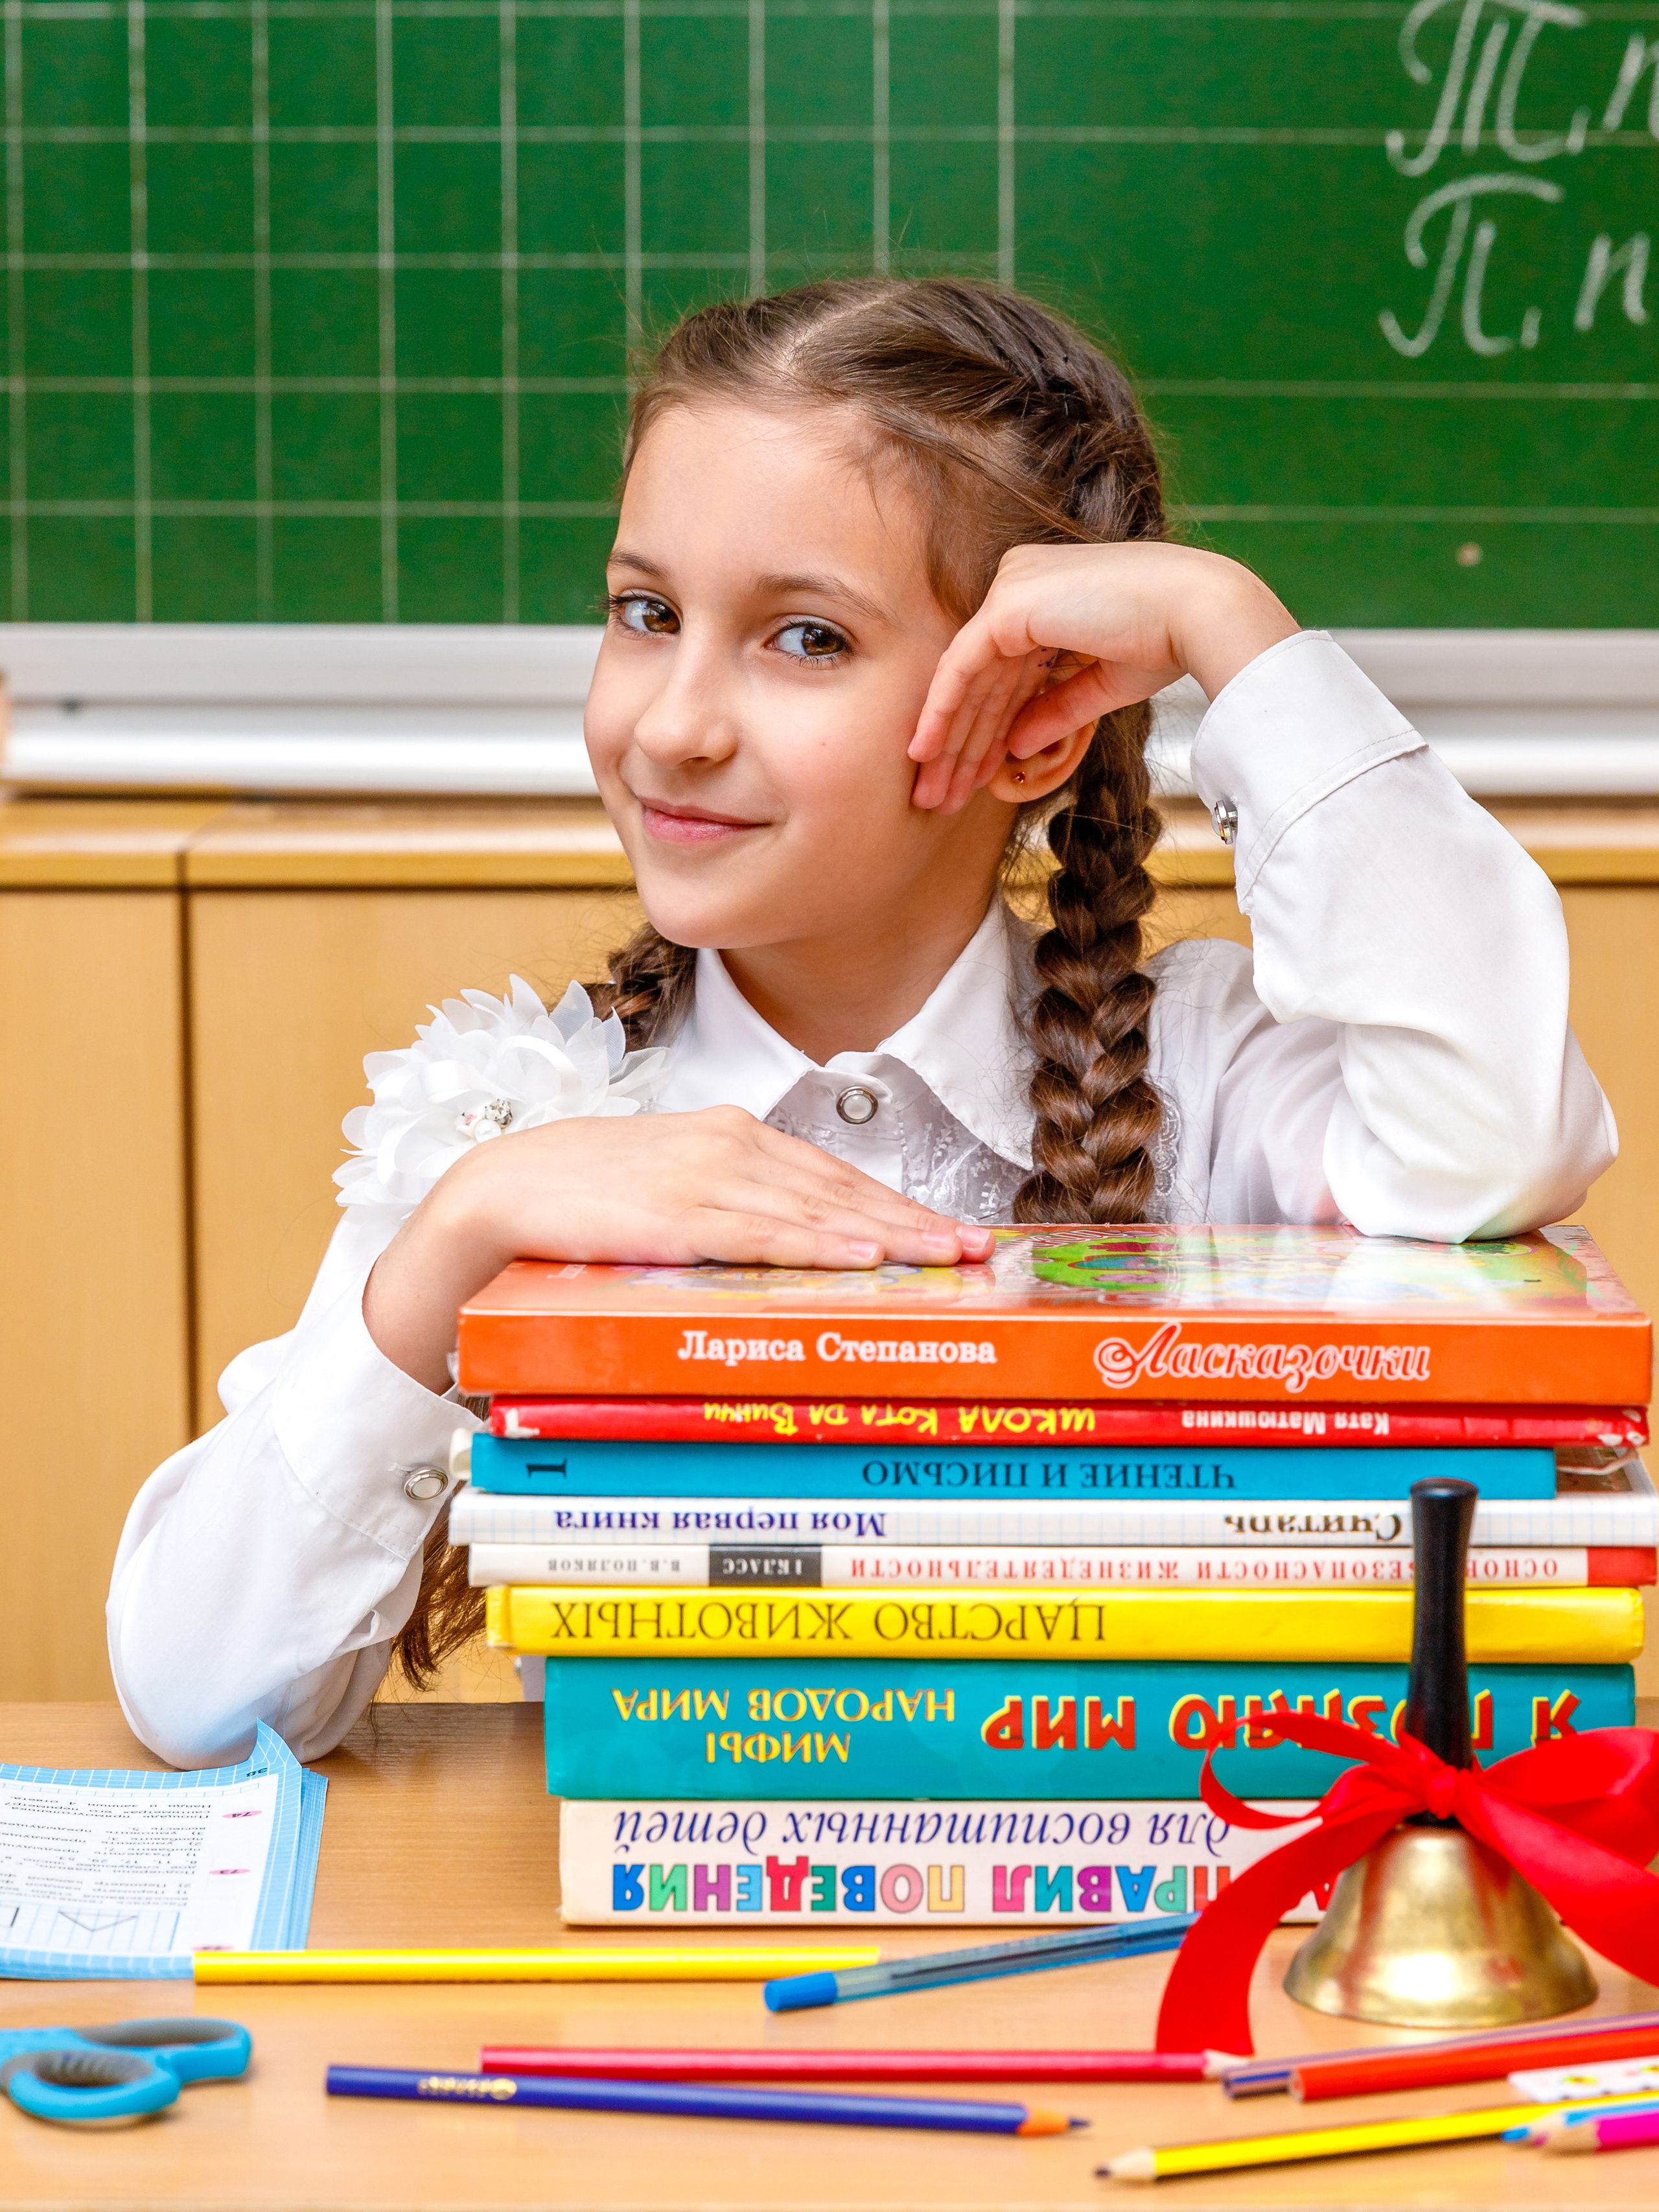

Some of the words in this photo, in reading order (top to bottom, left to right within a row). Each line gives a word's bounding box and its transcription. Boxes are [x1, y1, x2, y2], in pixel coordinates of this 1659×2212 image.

[678, 1331, 806, 1366] Лариса
[817, 1332, 998, 1365] Степанова
[1094, 1321, 1431, 1393] Ласказочки
[1181, 1410, 1327, 1436] Матюшкина
[1334, 1412, 1389, 1436] Катя
[527, 1458, 568, 1478] 1
[863, 1460, 1030, 1488] ПИСЬМО
[1042, 1463, 1069, 1488] И
[1082, 1463, 1236, 1489] ЧТЕНИЕ
[555, 1511, 666, 1530] книга
[674, 1508, 800, 1532] первая
[811, 1511, 887, 1537] Моя
[1225, 1513, 1402, 1543] Считарь
[722, 1557, 789, 1576] КЛАСС
[852, 1557, 1179, 1580] ЖИЗНЕДЕЯТЕЛЬНОСТИ
[551, 1601, 854, 1640] ЖИВОТНЫХ
[874, 1596, 1106, 1641] ЦАРСТВО
[612, 1688, 729, 1721] МИРА
[747, 1688, 955, 1722] НАРОДОВ
[980, 1694, 1136, 1752] МИР
[706, 1732, 851, 1764] МИФЫ
[246, 1767, 268, 1777] 38
[614, 1811, 767, 1856] детей
[782, 1811, 1131, 1845] воспитанных
[1148, 1813, 1231, 1857] для
[612, 1855, 965, 1913] ПОВЕДЕНИЯ
[992, 1864, 1231, 1913] ПРАВИЛ
